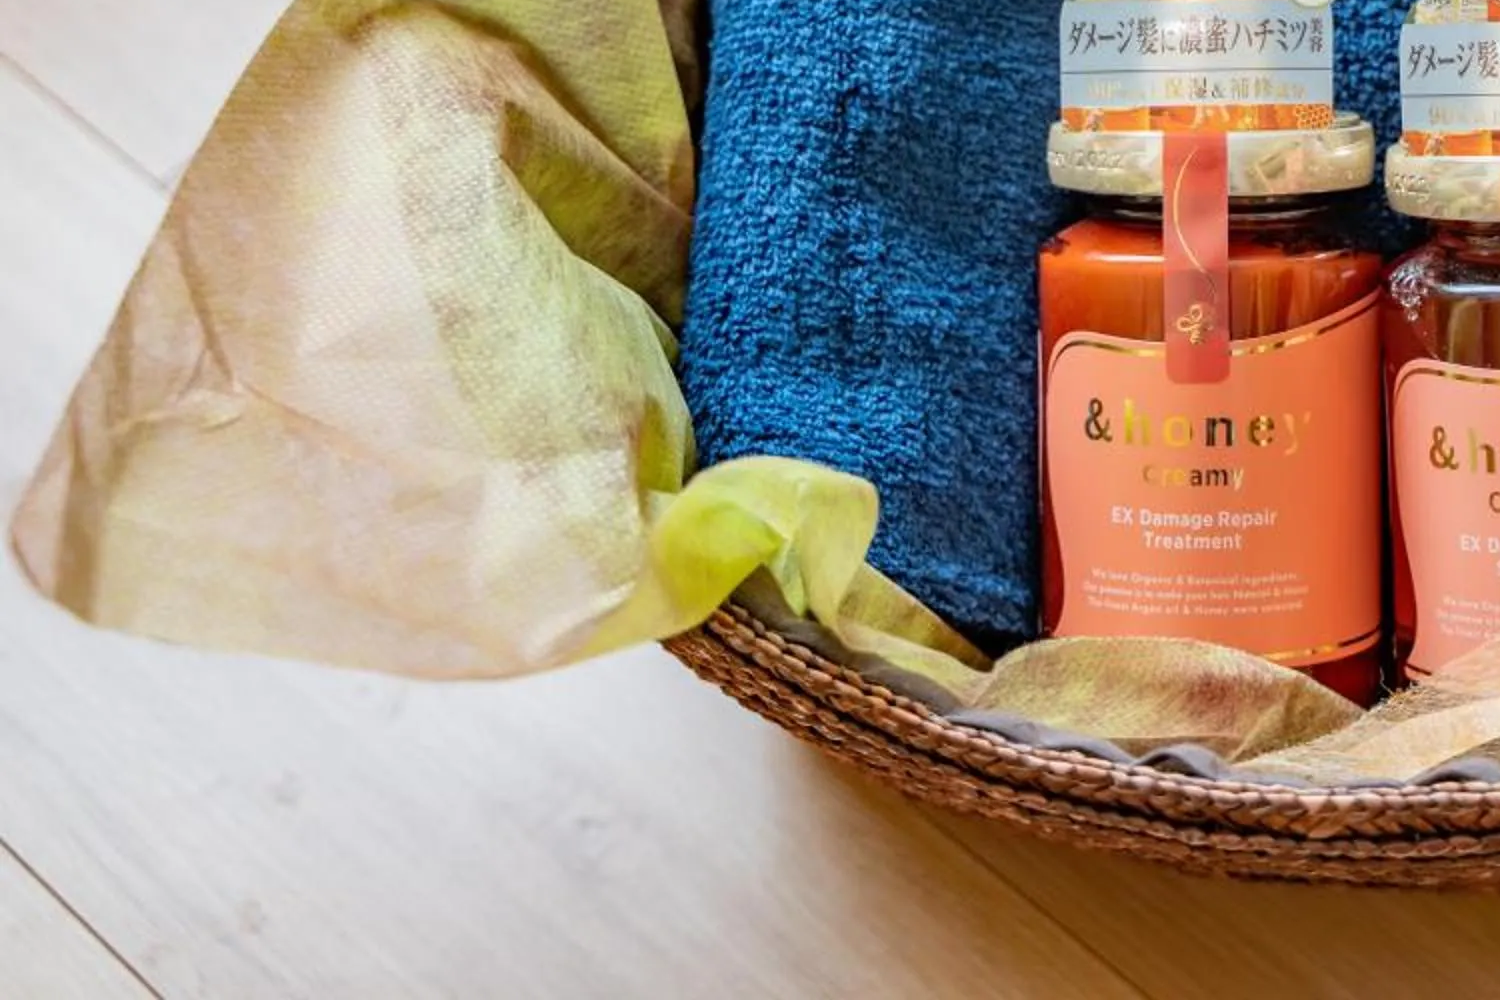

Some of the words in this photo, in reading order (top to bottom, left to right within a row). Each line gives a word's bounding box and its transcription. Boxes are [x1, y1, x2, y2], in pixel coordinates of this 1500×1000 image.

[1142, 464, 1245, 491] Creamy
[1111, 506, 1133, 525] EX
[1139, 508, 1213, 530] Damage
[1218, 510, 1278, 532] Repair
[1143, 530, 1242, 550] Treatment
[1460, 534, 1482, 552] EX
